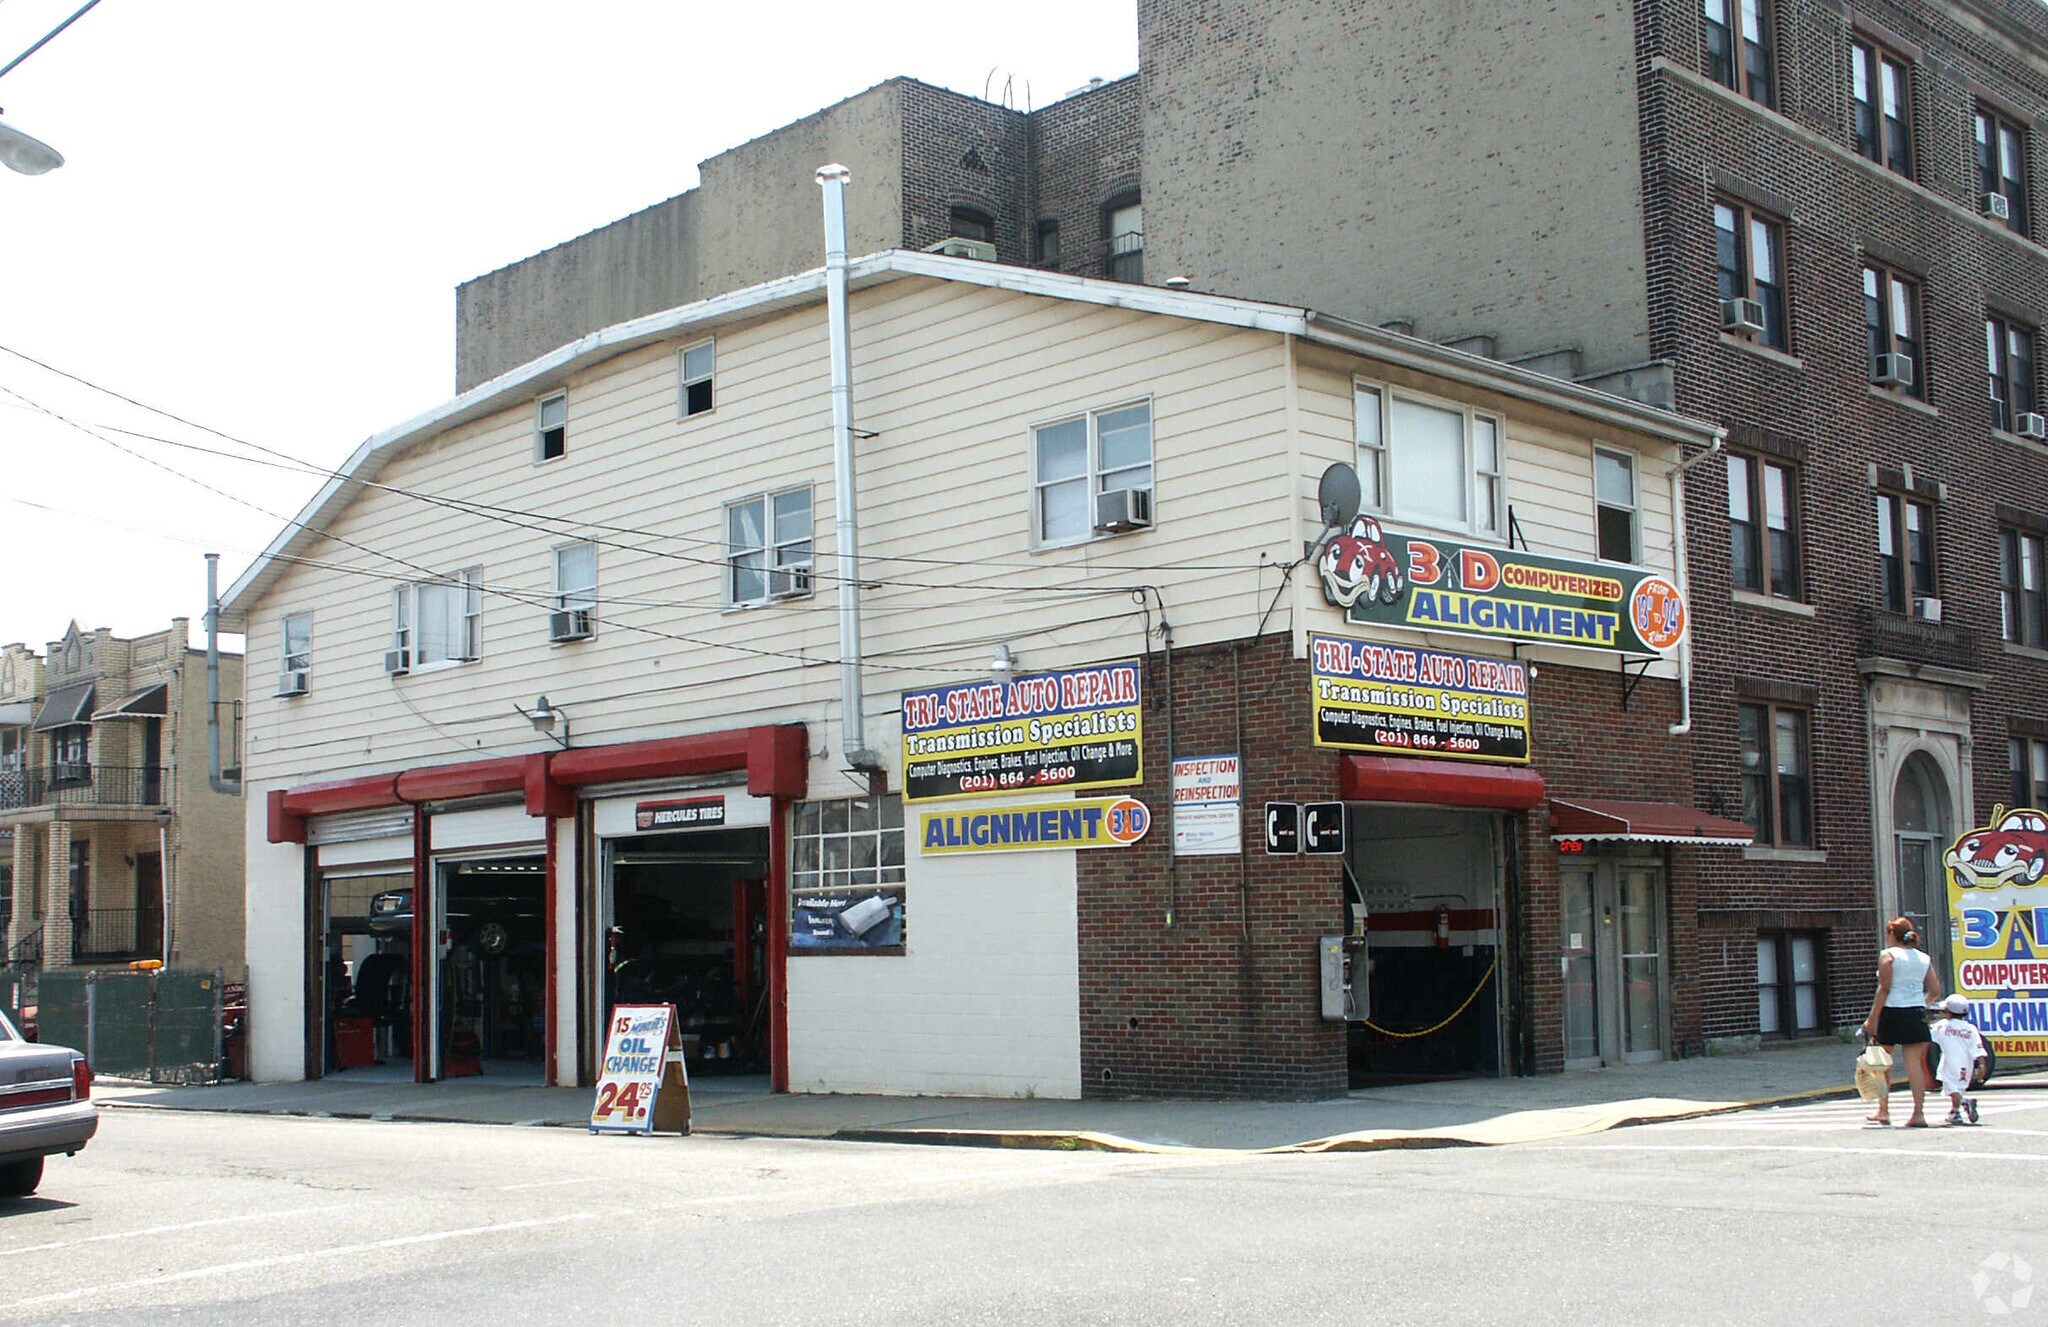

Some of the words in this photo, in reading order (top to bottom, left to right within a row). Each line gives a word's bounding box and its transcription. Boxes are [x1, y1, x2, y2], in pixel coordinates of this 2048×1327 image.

[1502, 564, 1621, 599] COMPUTERIZED
[1412, 591, 1616, 641] ALIGNMENT
[1315, 639, 1417, 682] TRI-STATE
[1419, 653, 1465, 688] AUTO
[1467, 660, 1525, 695] REPAIR
[904, 684, 1003, 728] TRI-STATE
[1005, 677, 1058, 715] AUTO
[1061, 668, 1136, 709] REPAIR
[1318, 679, 1436, 710] Transmission
[1440, 692, 1524, 719] Specialists
[907, 724, 1024, 755] Transmission
[1029, 711, 1136, 745] Specialists
[1321, 707, 1350, 726] Computer
[1436, 719, 1448, 733] Fuel
[1484, 724, 1504, 741] Change
[1375, 729, 1408, 746] (201)
[1413, 733, 1437, 747] 864
[1450, 737, 1480, 750] 5600
[909, 763, 936, 780] Computer
[1024, 750, 1038, 766] Fuel
[1070, 746, 1080, 761] Oil
[1082, 744, 1107, 763] Change
[1116, 741, 1133, 757] More
[1174, 759, 1237, 776] INSPECTION
[959, 772, 995, 791] (201)
[1000, 771, 1025, 785] 864
[1040, 766, 1076, 780] 5600
[1174, 784, 1240, 801] REINSPECTION
[654, 808, 698, 824] HERCULES
[699, 806, 724, 821] TIRES
[924, 807, 1102, 848] ALIGNMENT
[616, 1017, 631, 1034] 15
[620, 1038, 651, 1053] OIL
[606, 1056, 658, 1073] CHANGE
